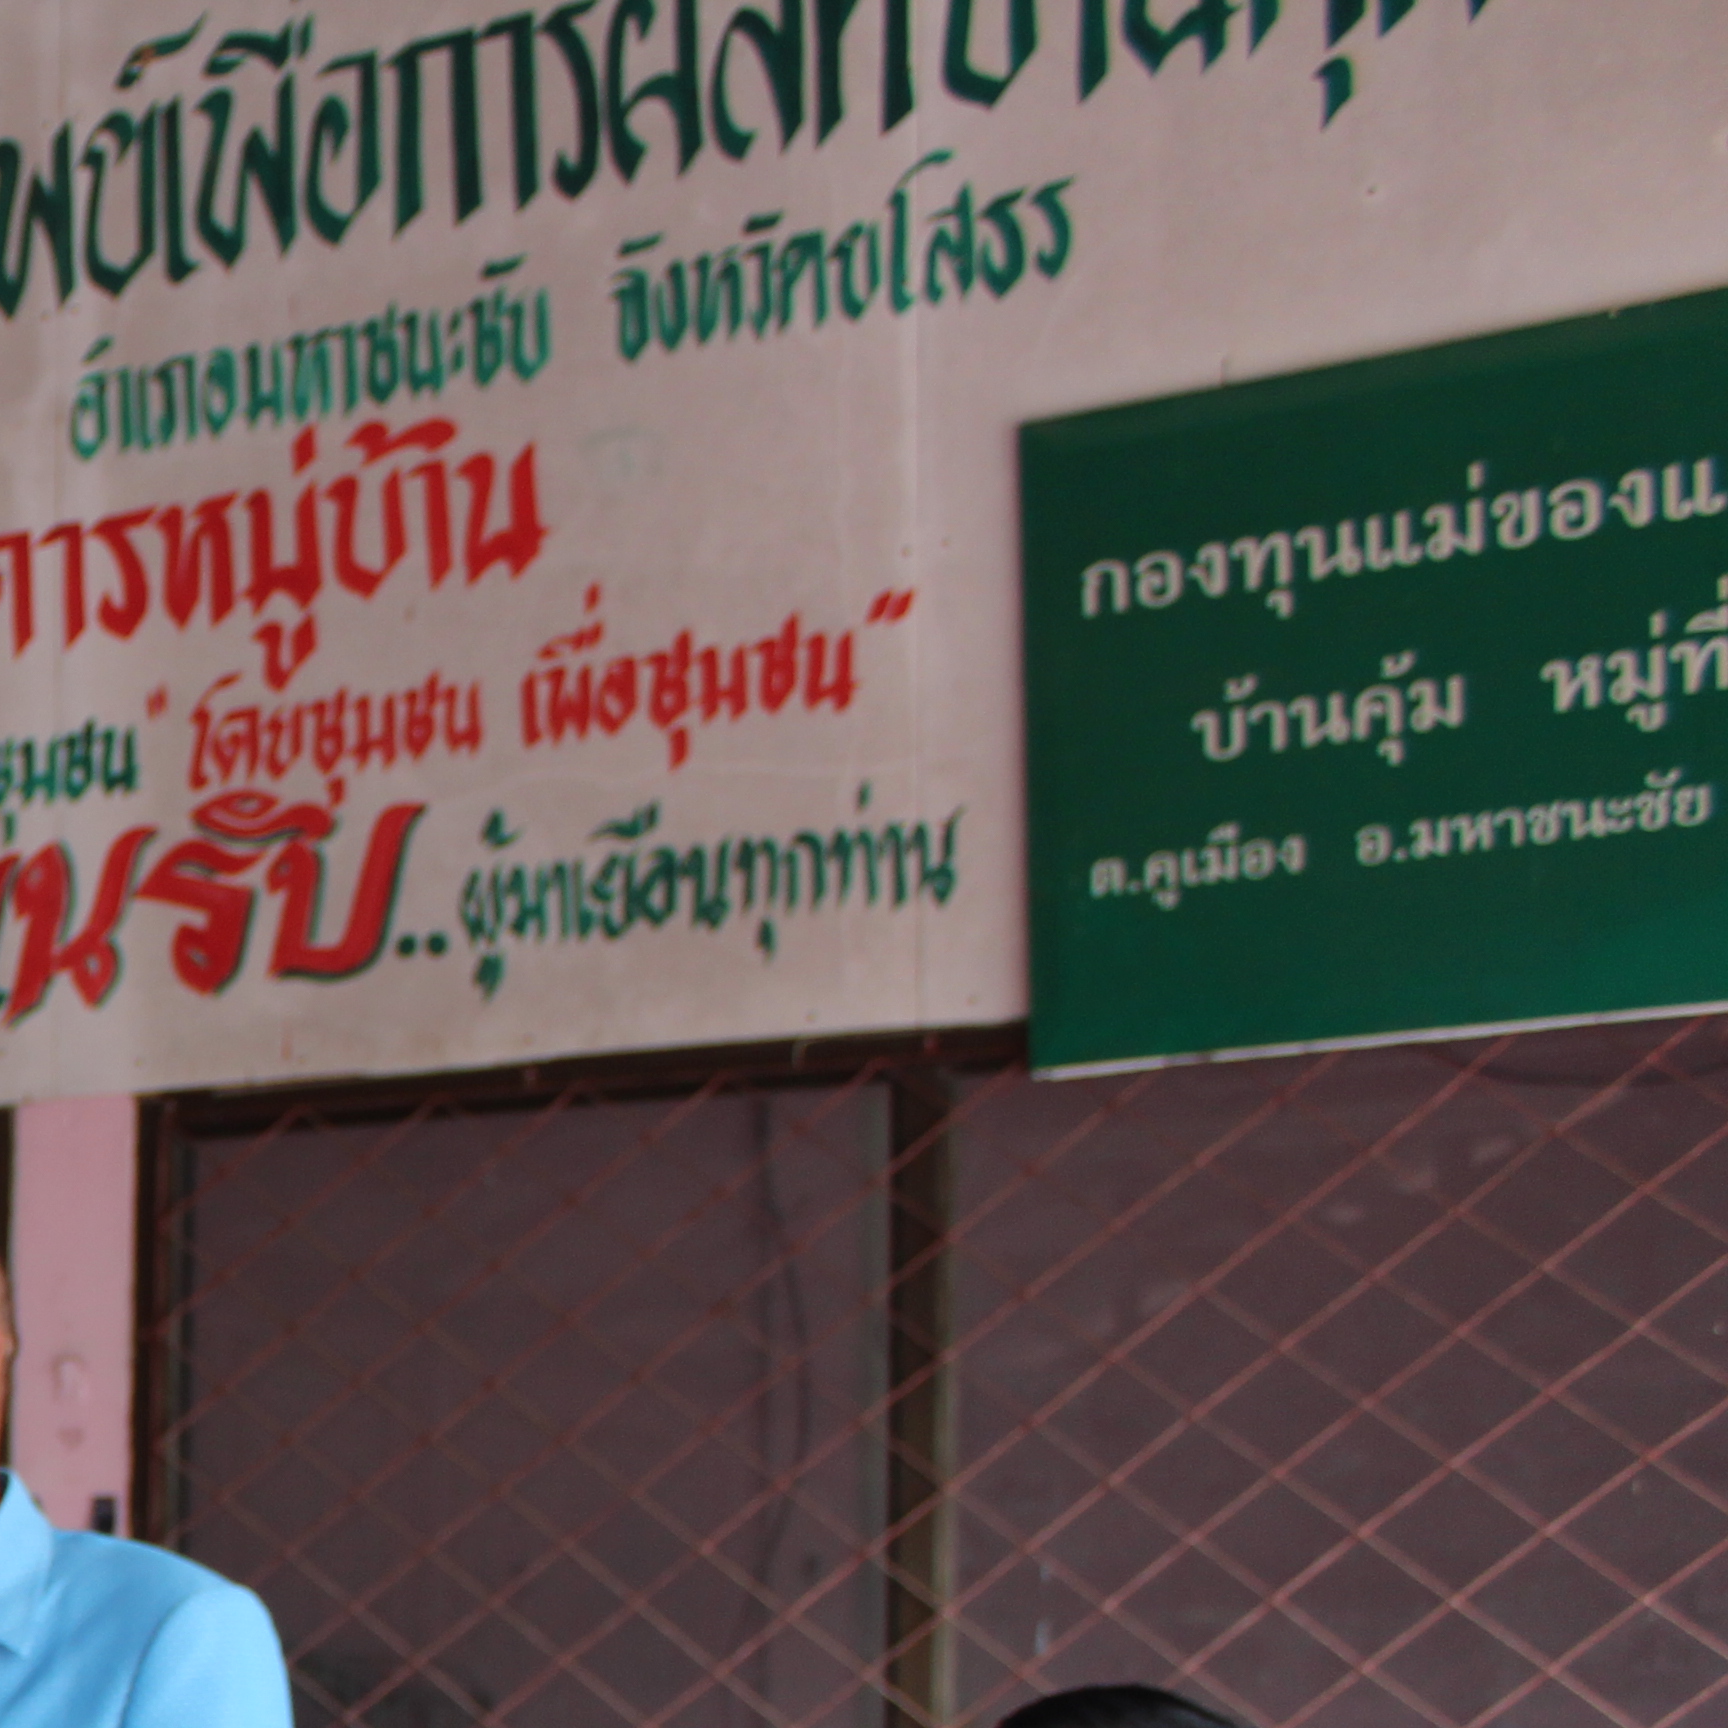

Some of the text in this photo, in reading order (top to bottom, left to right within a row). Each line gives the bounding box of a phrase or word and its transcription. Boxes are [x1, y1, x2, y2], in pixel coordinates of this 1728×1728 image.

[612, 150, 1077, 361] จังหวัดยโสธร
[1190, 650, 1466, 766] บ้านคุ้ม
[1089, 766, 1713, 910] ต.คูเมือง อ.มหาชนะชัย
